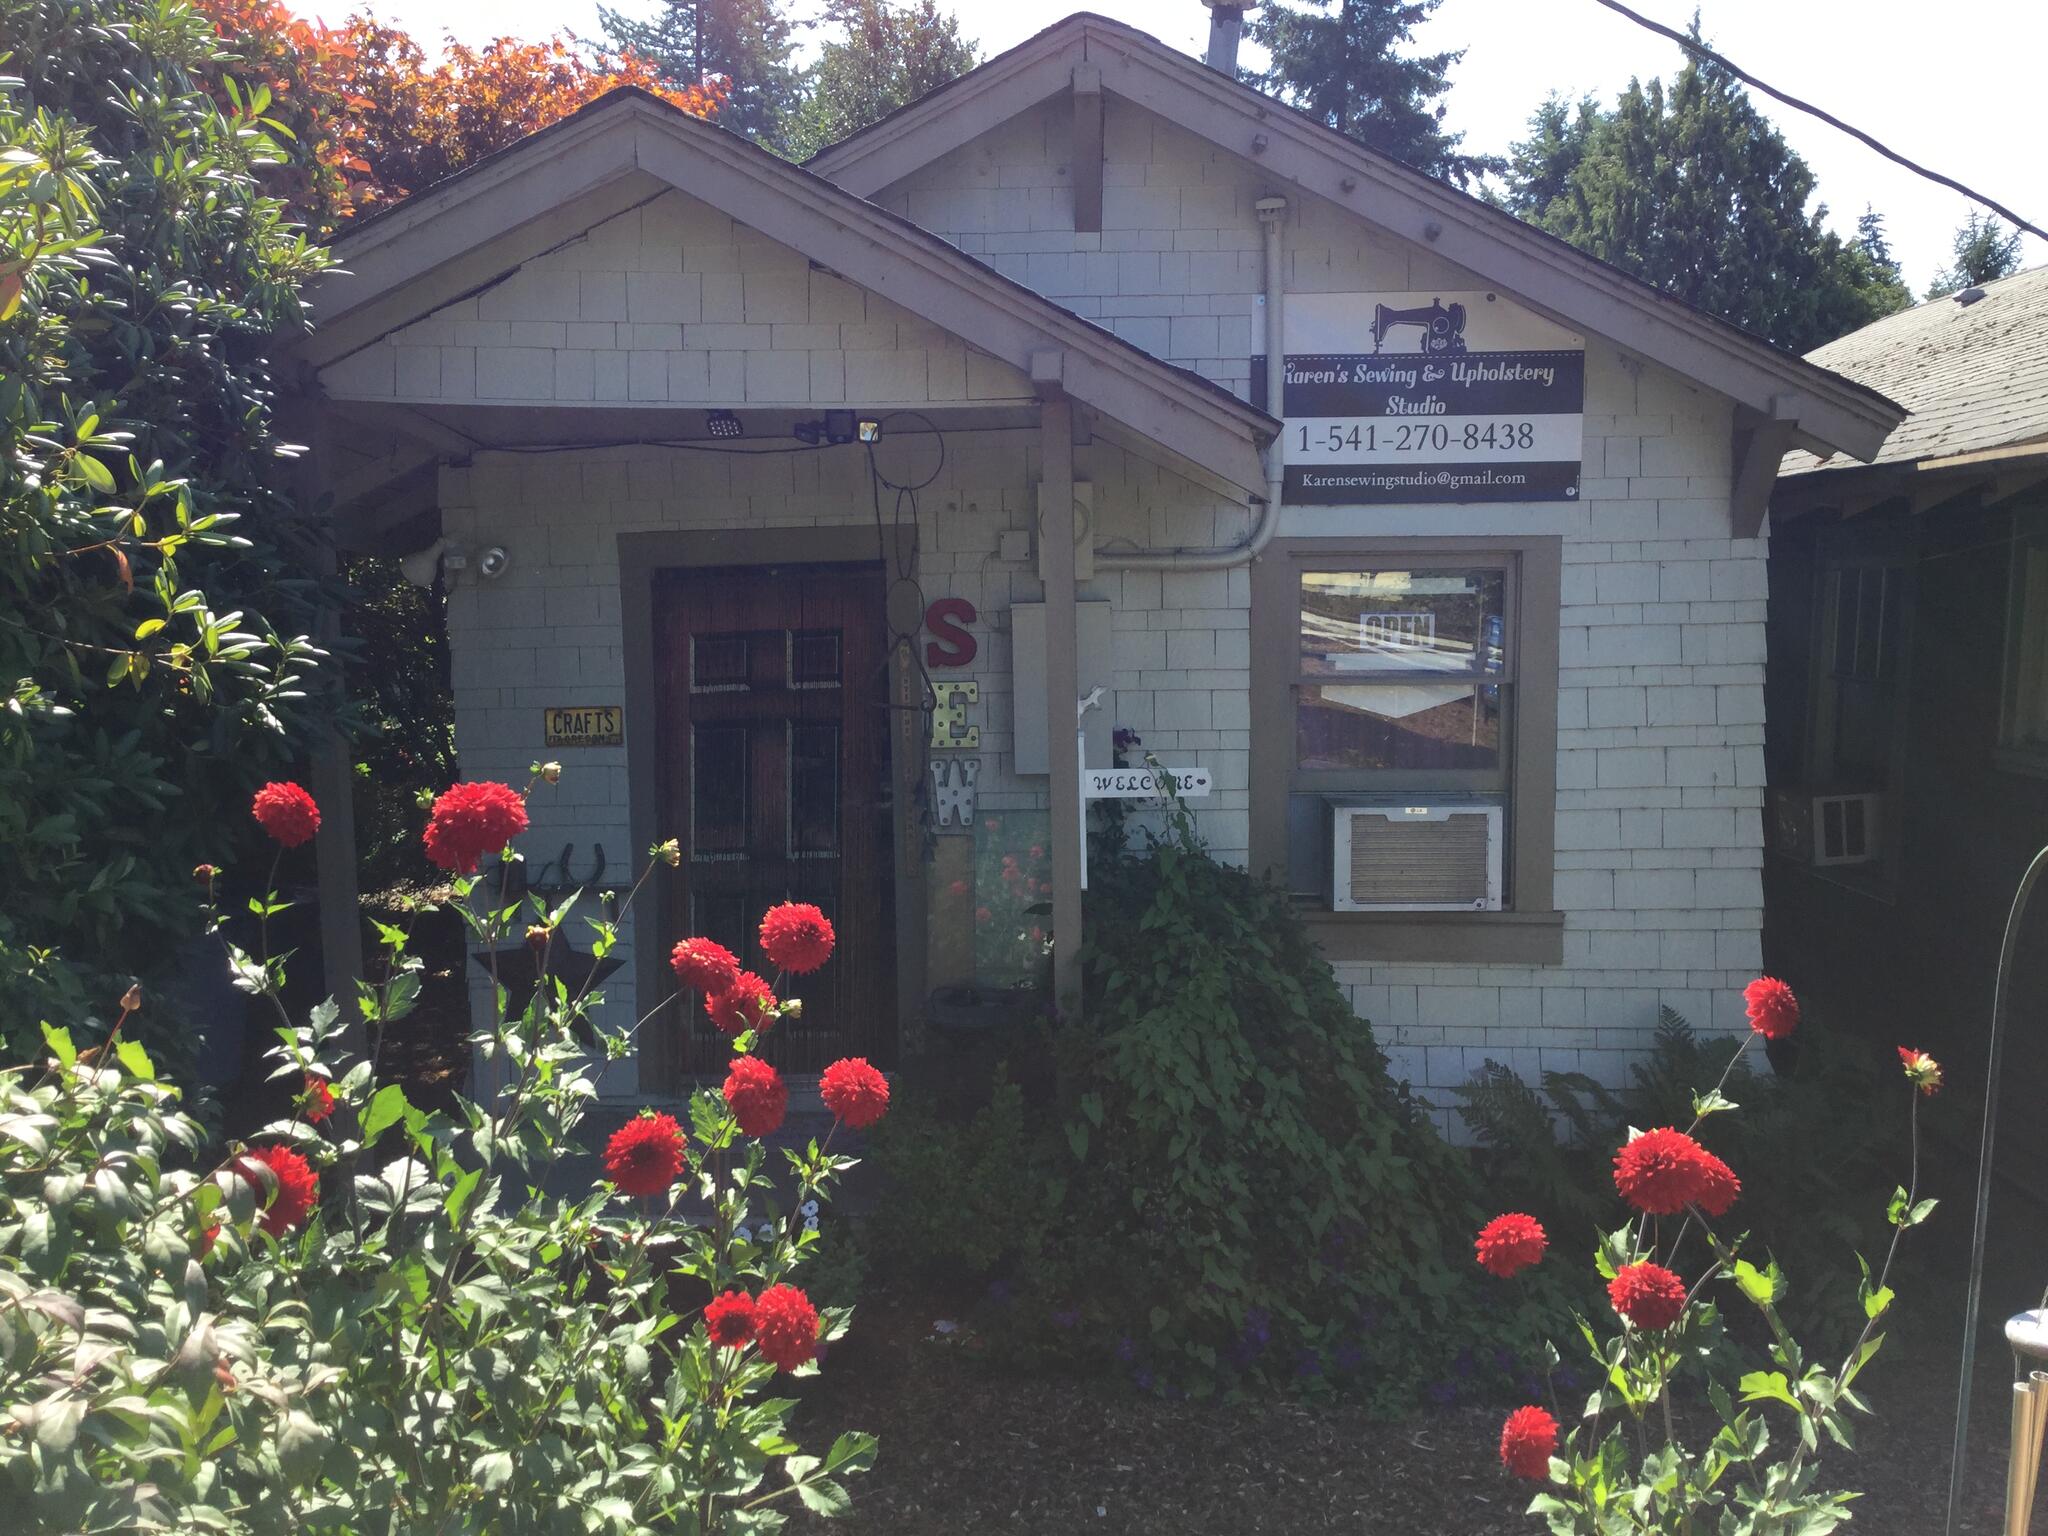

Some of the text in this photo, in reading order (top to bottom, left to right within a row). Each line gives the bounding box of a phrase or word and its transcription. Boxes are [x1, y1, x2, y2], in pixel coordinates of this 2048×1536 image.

[1283, 361, 1554, 389] Karen's Sewing & Upholstery
[1385, 394, 1447, 415] Studio
[1299, 422, 1534, 452] 1-541-270-8438
[1302, 470, 1526, 490] Karensewingstudio@gmail.com
[1366, 615, 1430, 647] OPEN
[553, 711, 614, 734] CRAFTS
